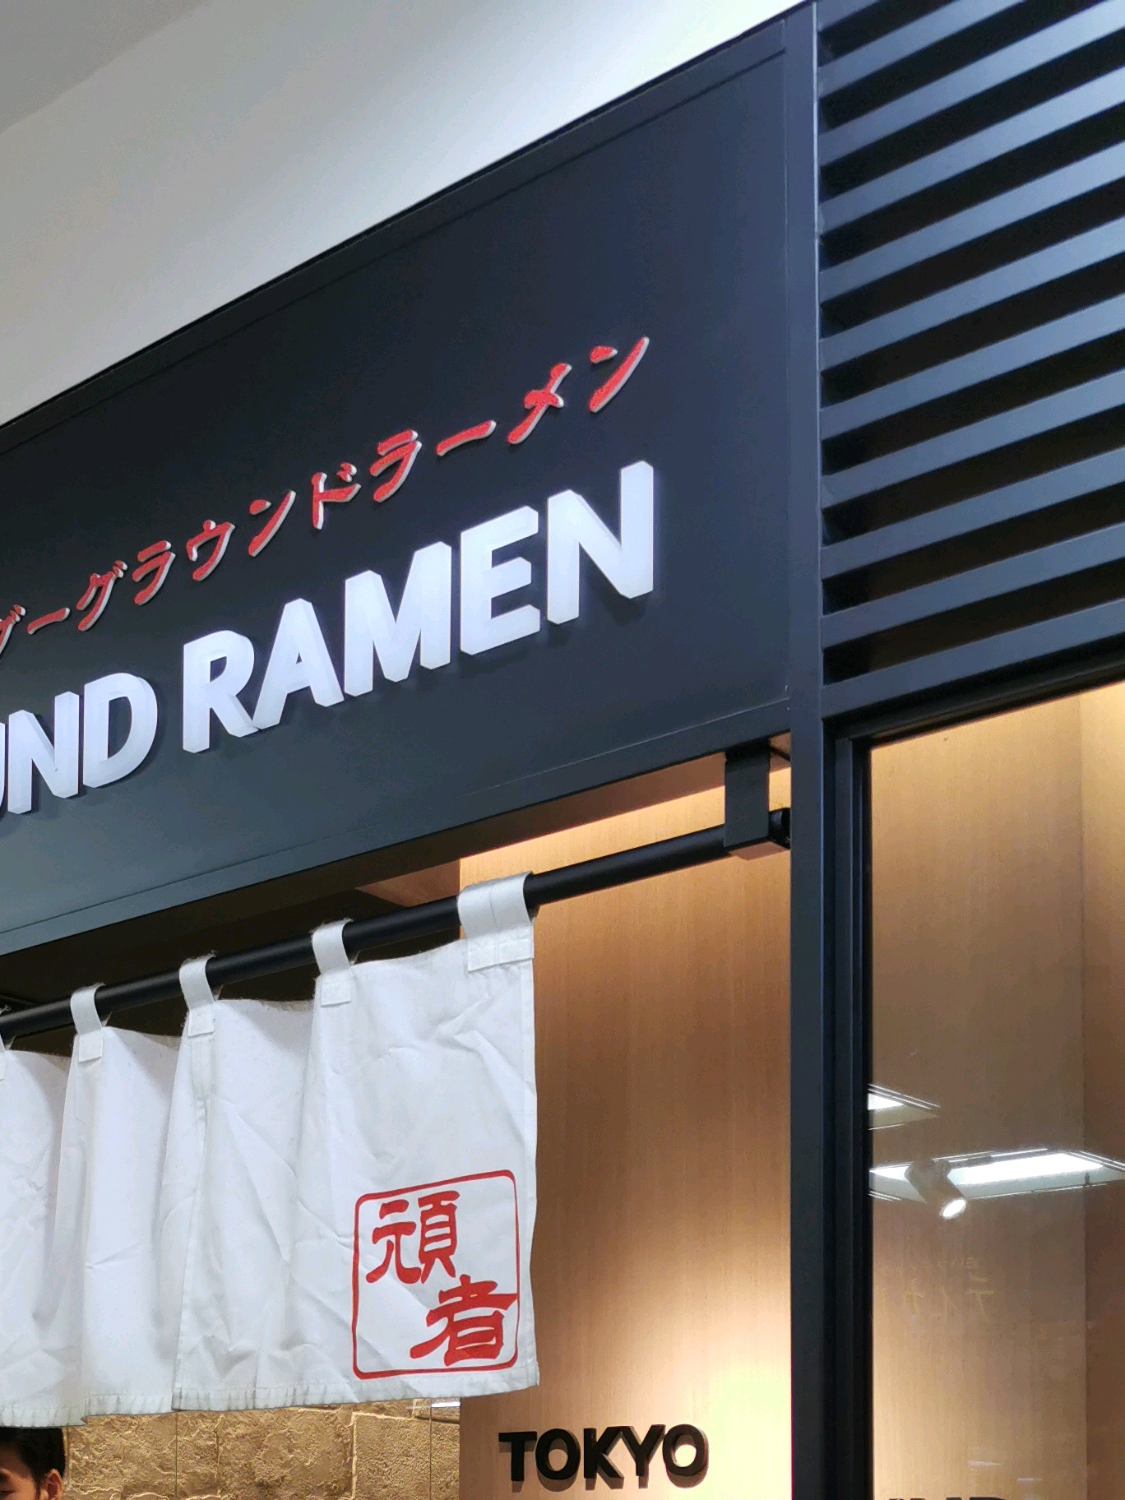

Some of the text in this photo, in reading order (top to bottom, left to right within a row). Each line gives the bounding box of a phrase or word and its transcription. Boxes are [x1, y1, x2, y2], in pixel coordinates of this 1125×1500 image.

[182, 460, 654, 753] RAMEN
[366, 1190, 517, 1366] 頑者
[499, 1425, 709, 1489] TOKYO
